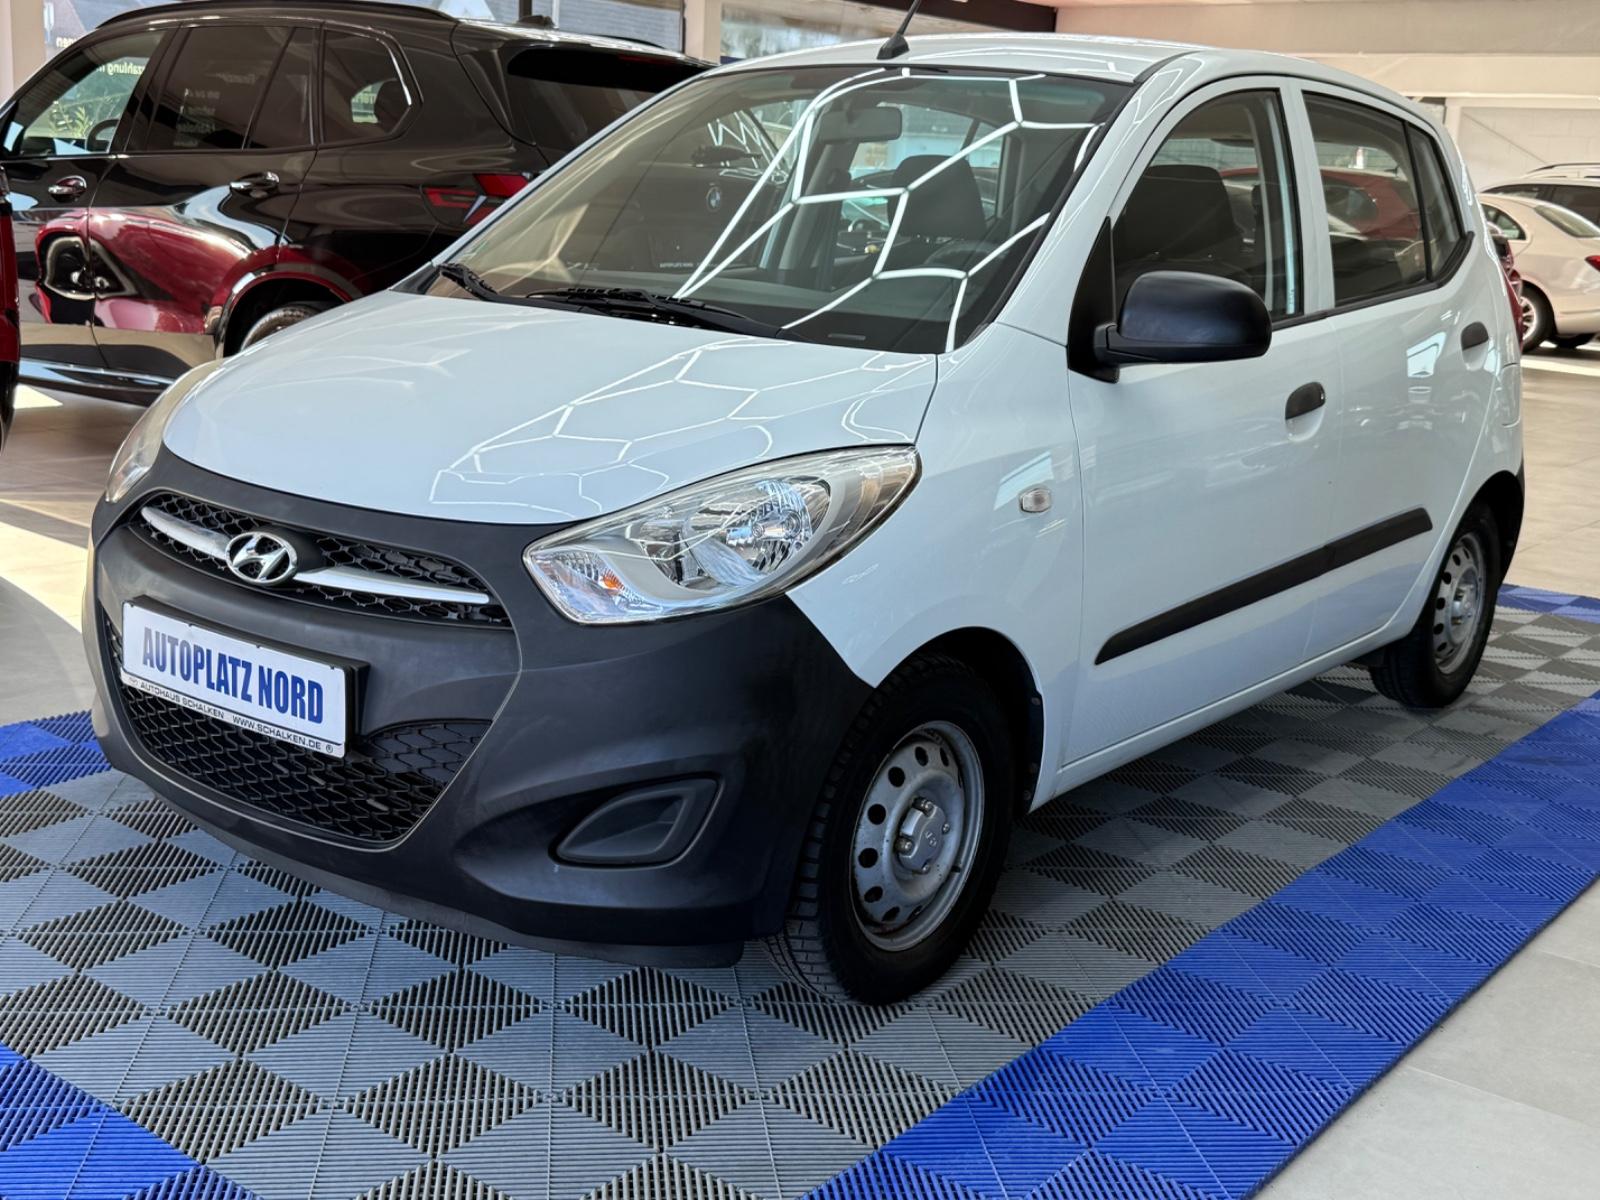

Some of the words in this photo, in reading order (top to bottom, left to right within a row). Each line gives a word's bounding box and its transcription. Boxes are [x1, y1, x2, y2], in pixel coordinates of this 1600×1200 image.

[140, 682, 181, 704] AUTOHAUS
[182, 698, 225, 719] SCHALKEN
[232, 715, 321, 751] WWW.SCHALKEN.DE
[142, 627, 253, 704] AUTOPLATZ
[258, 664, 324, 724] NORD
